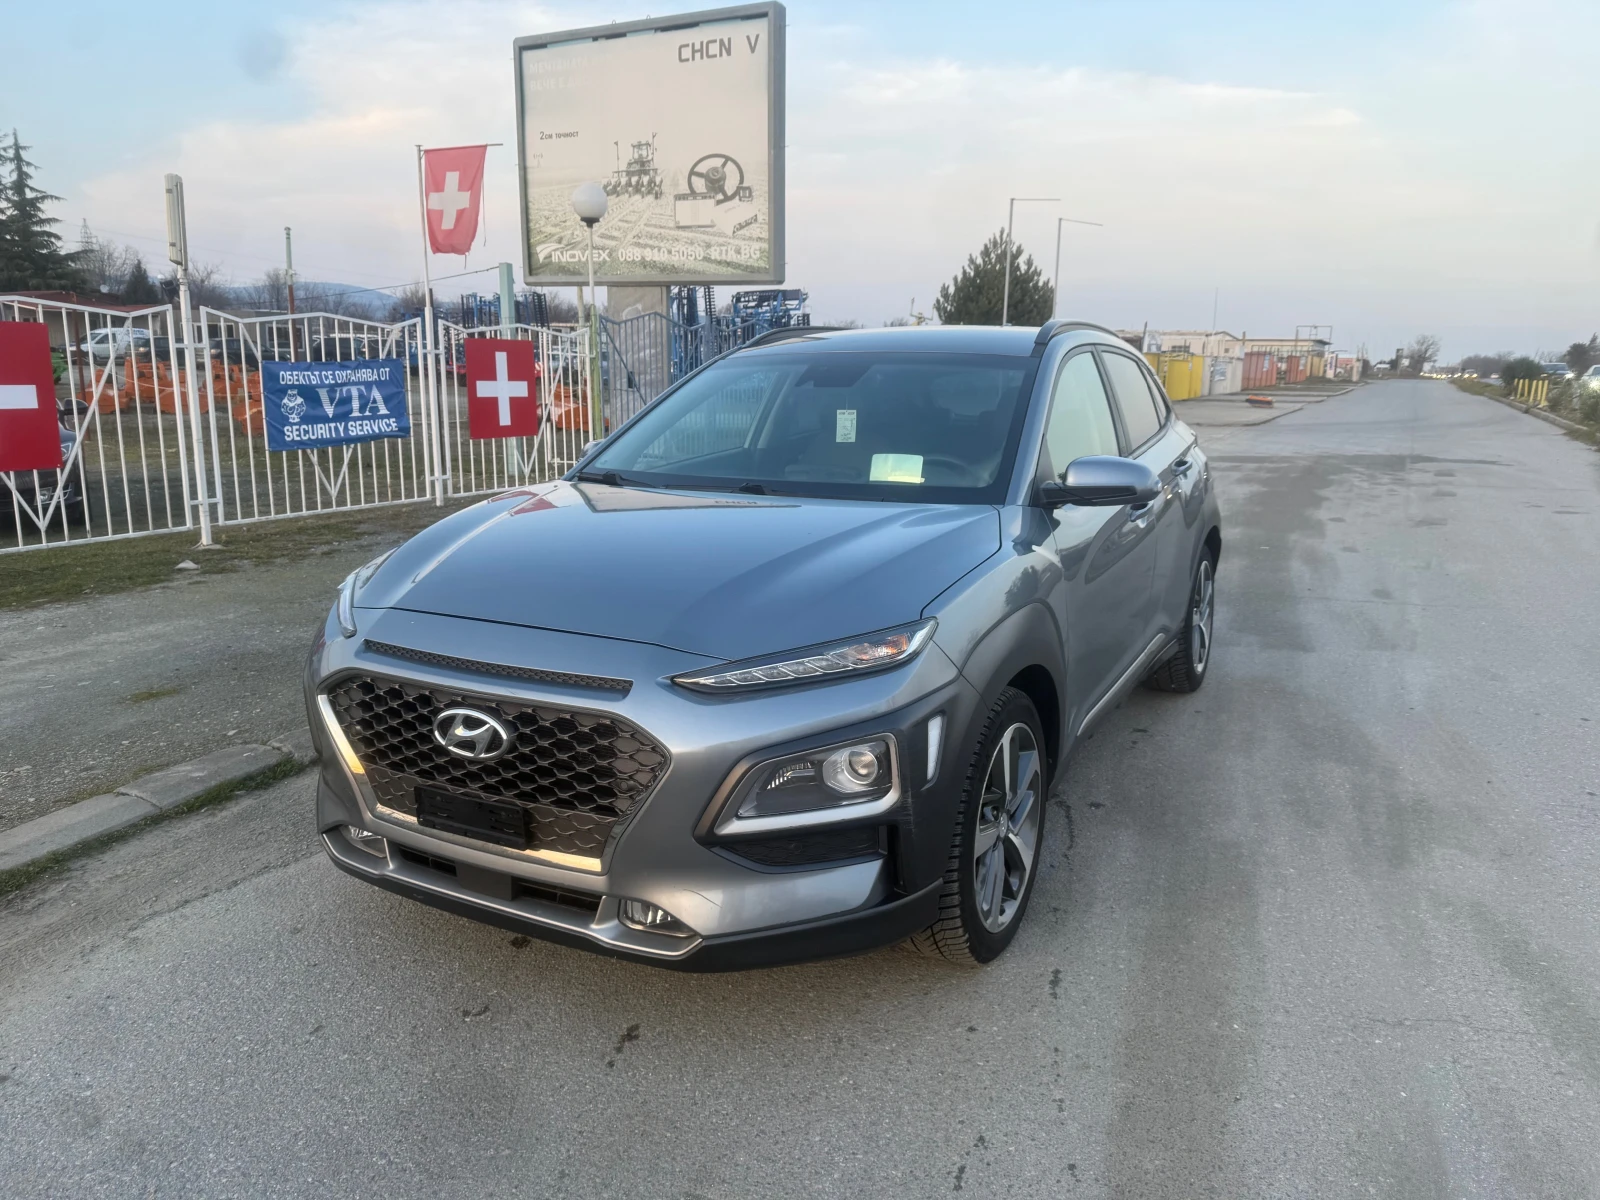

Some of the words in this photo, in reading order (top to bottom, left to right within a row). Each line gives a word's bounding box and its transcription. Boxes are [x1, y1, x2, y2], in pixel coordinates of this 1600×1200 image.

[551, 249, 610, 263] INOVEX
[618, 248, 641, 262] 088
[672, 246, 703, 260] 5050
[279, 370, 320, 385] ОБЕКТЪТ
[321, 371, 335, 384] СЕ
[335, 368, 379, 384] ОХРАНЯВА
[379, 367, 390, 381] ОТ
[315, 384, 391, 419] VTA
[284, 421, 346, 441] SECURITY
[348, 418, 399, 436] SERVICE
